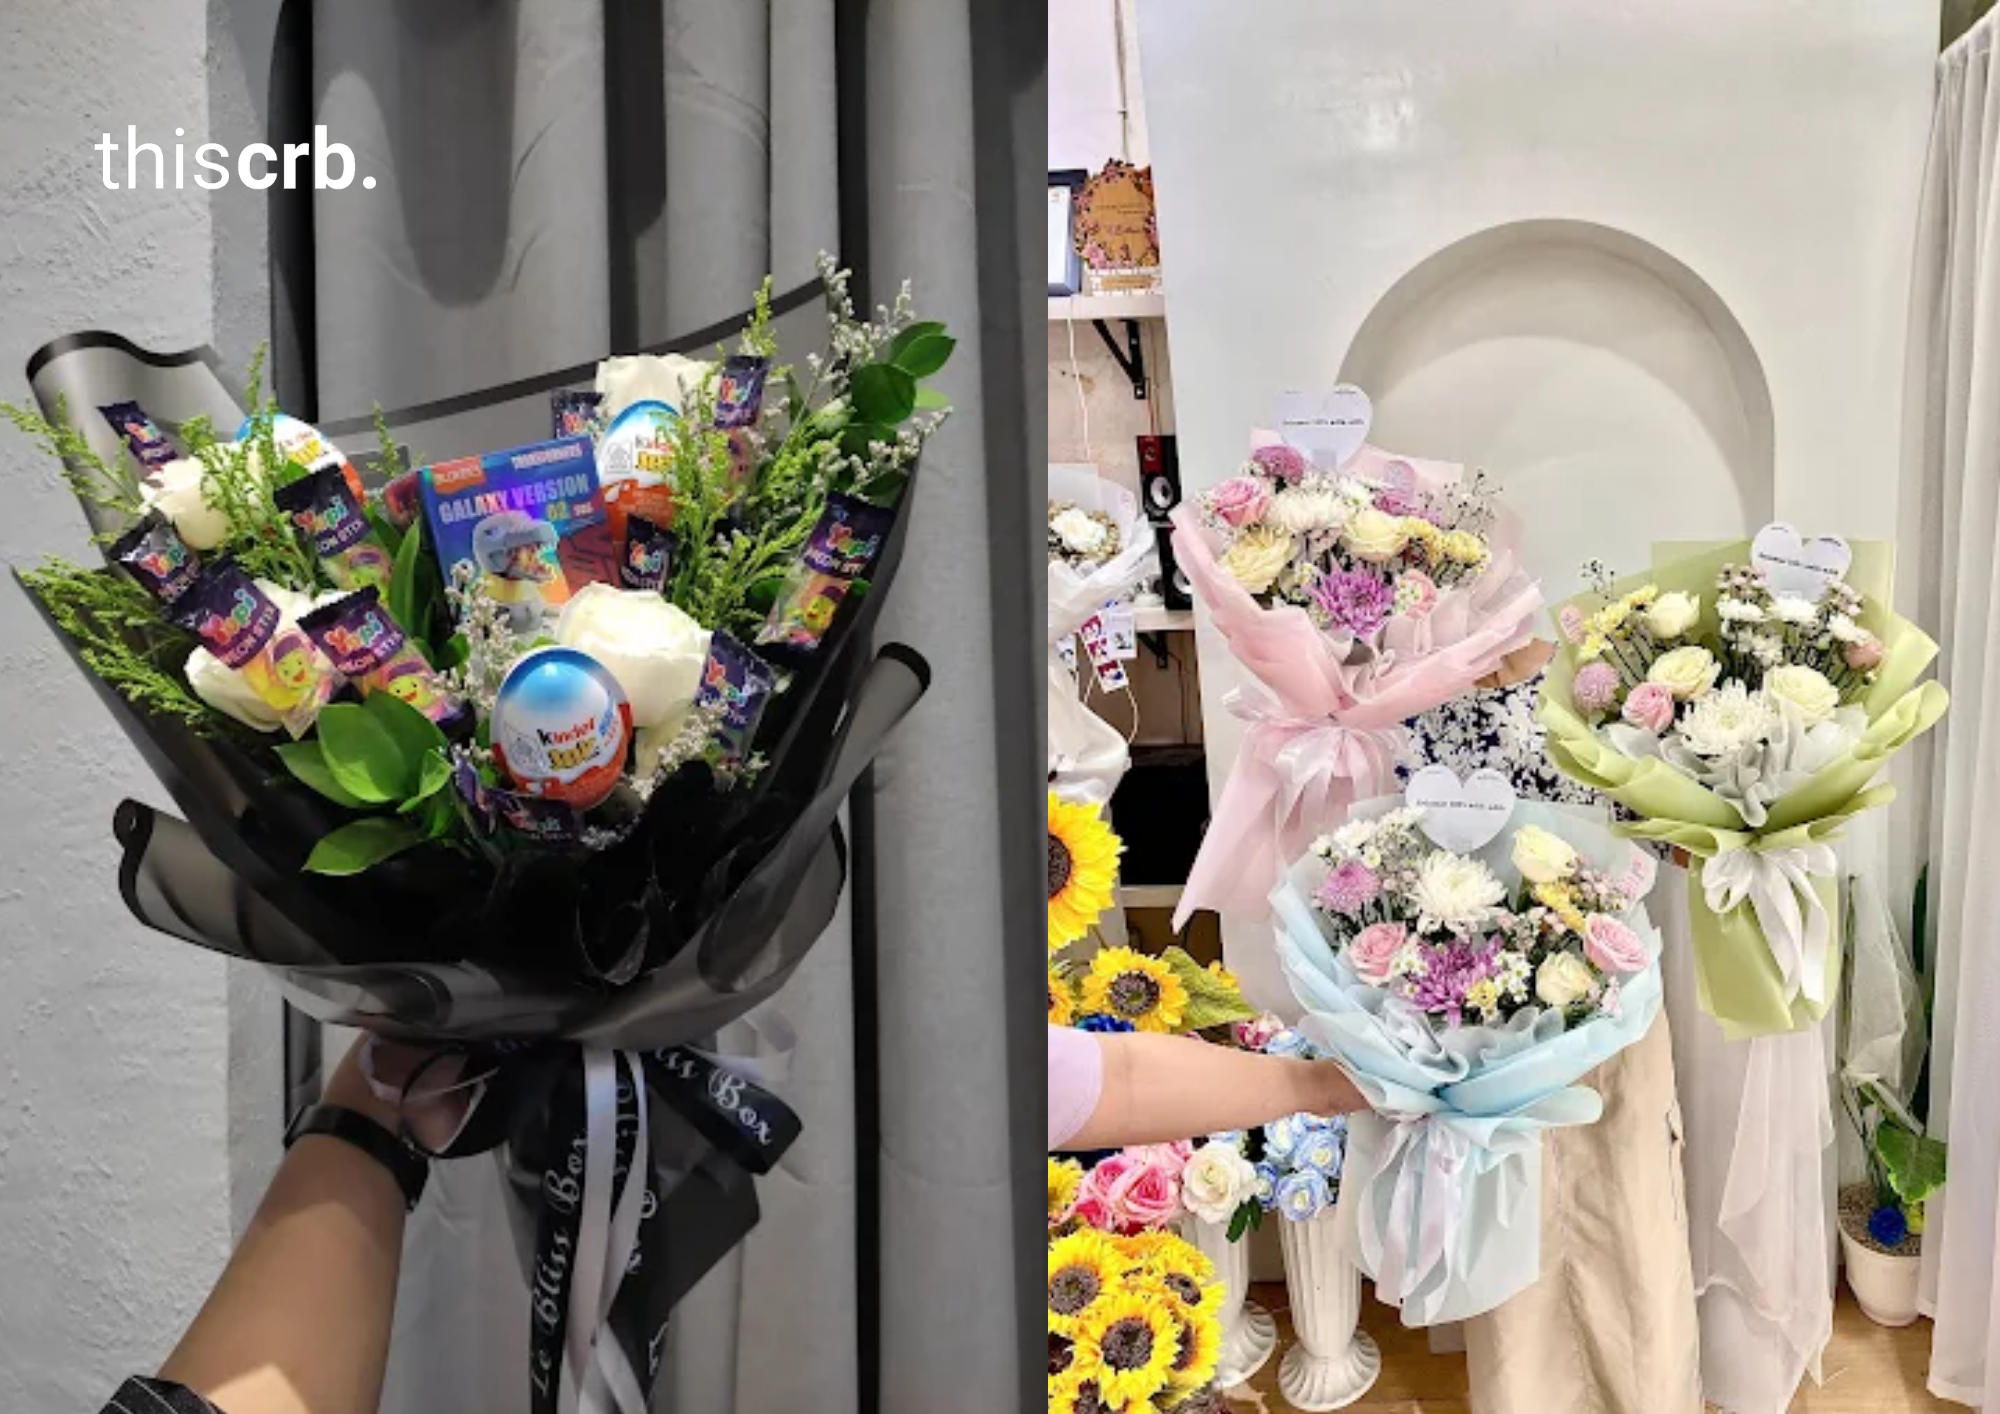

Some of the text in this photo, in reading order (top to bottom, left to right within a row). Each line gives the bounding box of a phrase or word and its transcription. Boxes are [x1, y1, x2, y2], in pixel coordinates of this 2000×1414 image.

[438, 473, 589, 524] GALAXY VERSION
[198, 588, 257, 646] Yupi
[323, 611, 384, 654] Yupi
[537, 717, 595, 746] kinder
[708, 1069, 772, 1146] Box
[533, 1229, 571, 1331] Bliss
